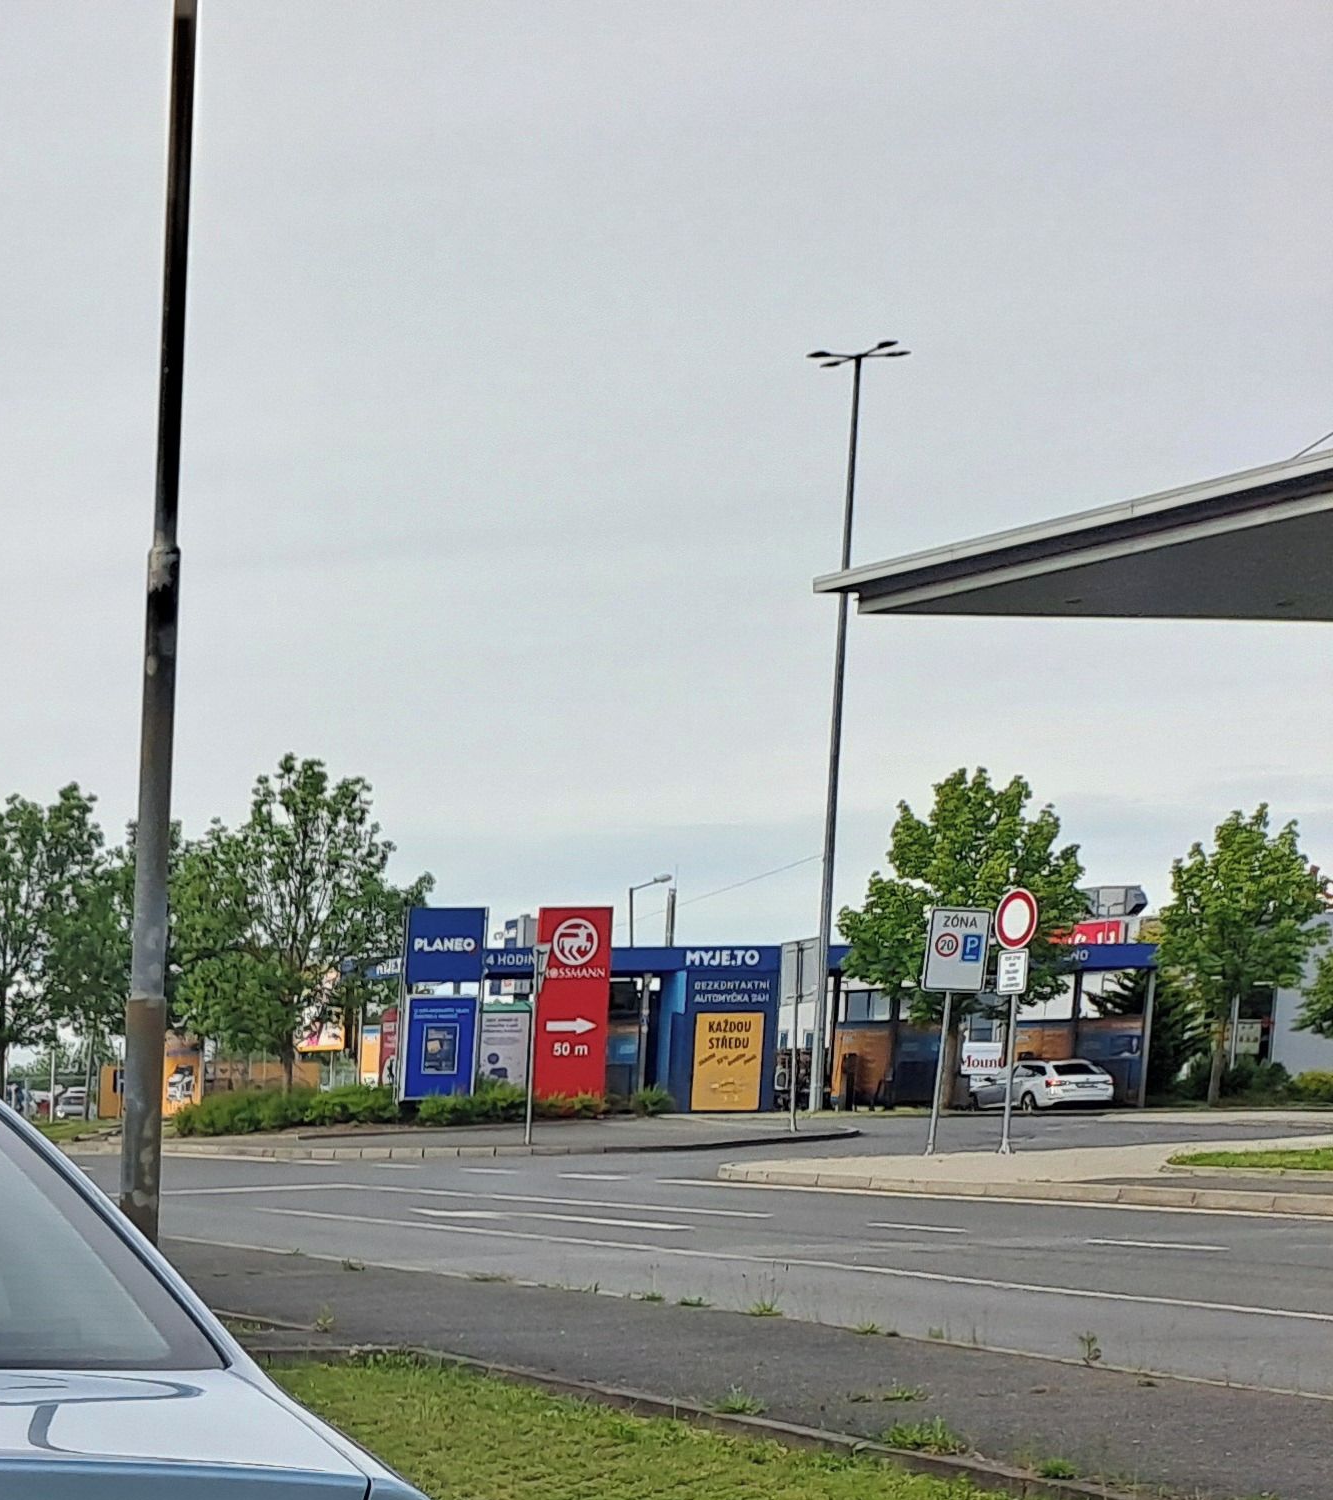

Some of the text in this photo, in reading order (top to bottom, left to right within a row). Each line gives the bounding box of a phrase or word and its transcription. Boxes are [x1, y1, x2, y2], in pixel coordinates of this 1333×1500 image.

[942, 913, 978, 929] ZÓNA
[413, 936, 477, 953] PLANEO
[939, 939, 954, 951] 20
[708, 1018, 752, 1033] KAŽDOU
[553, 1041, 589, 1056] 50 m
[708, 1035, 750, 1050] STŘEDU
